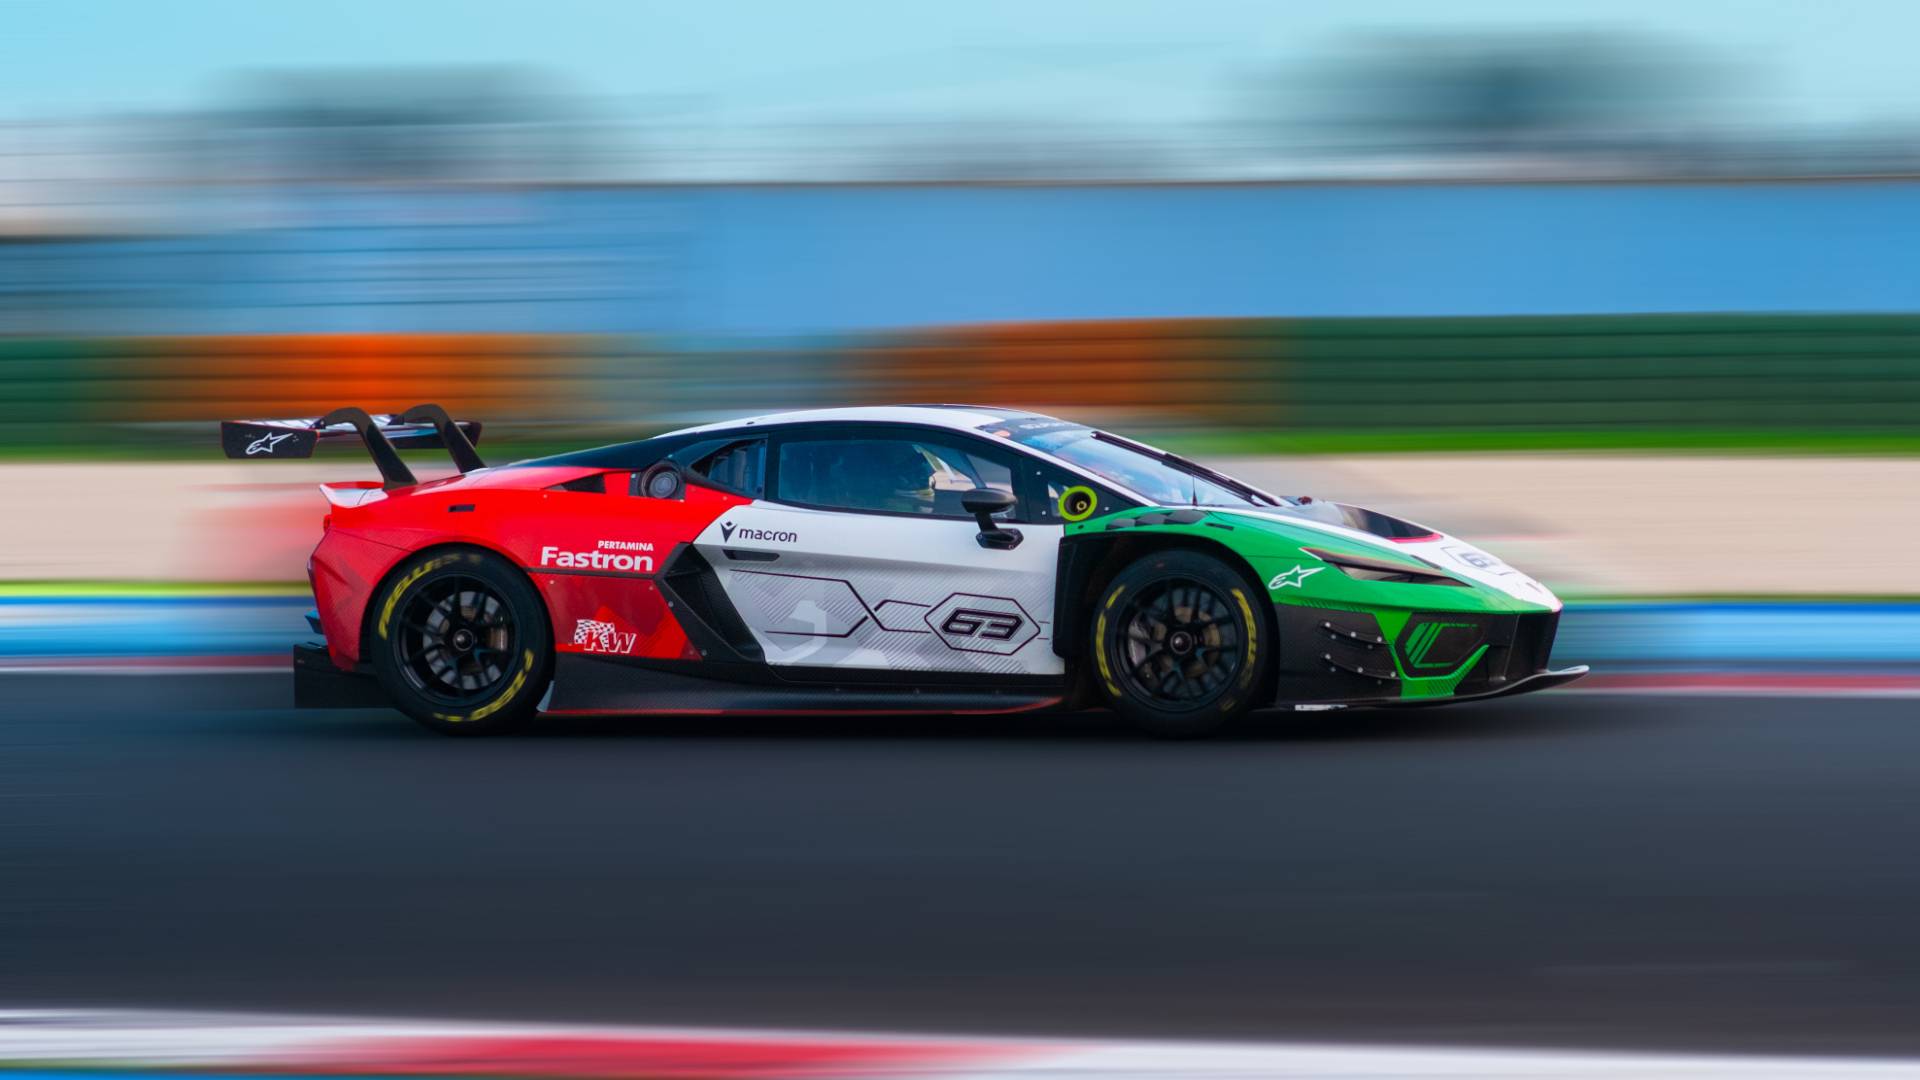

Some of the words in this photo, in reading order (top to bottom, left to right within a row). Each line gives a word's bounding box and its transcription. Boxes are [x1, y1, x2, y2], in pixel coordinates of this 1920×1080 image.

[598, 540, 654, 552] PERTAMINA
[739, 528, 798, 544] macron
[541, 546, 653, 572] Fastron
[941, 608, 1024, 641] 63
[584, 630, 637, 654] KW
